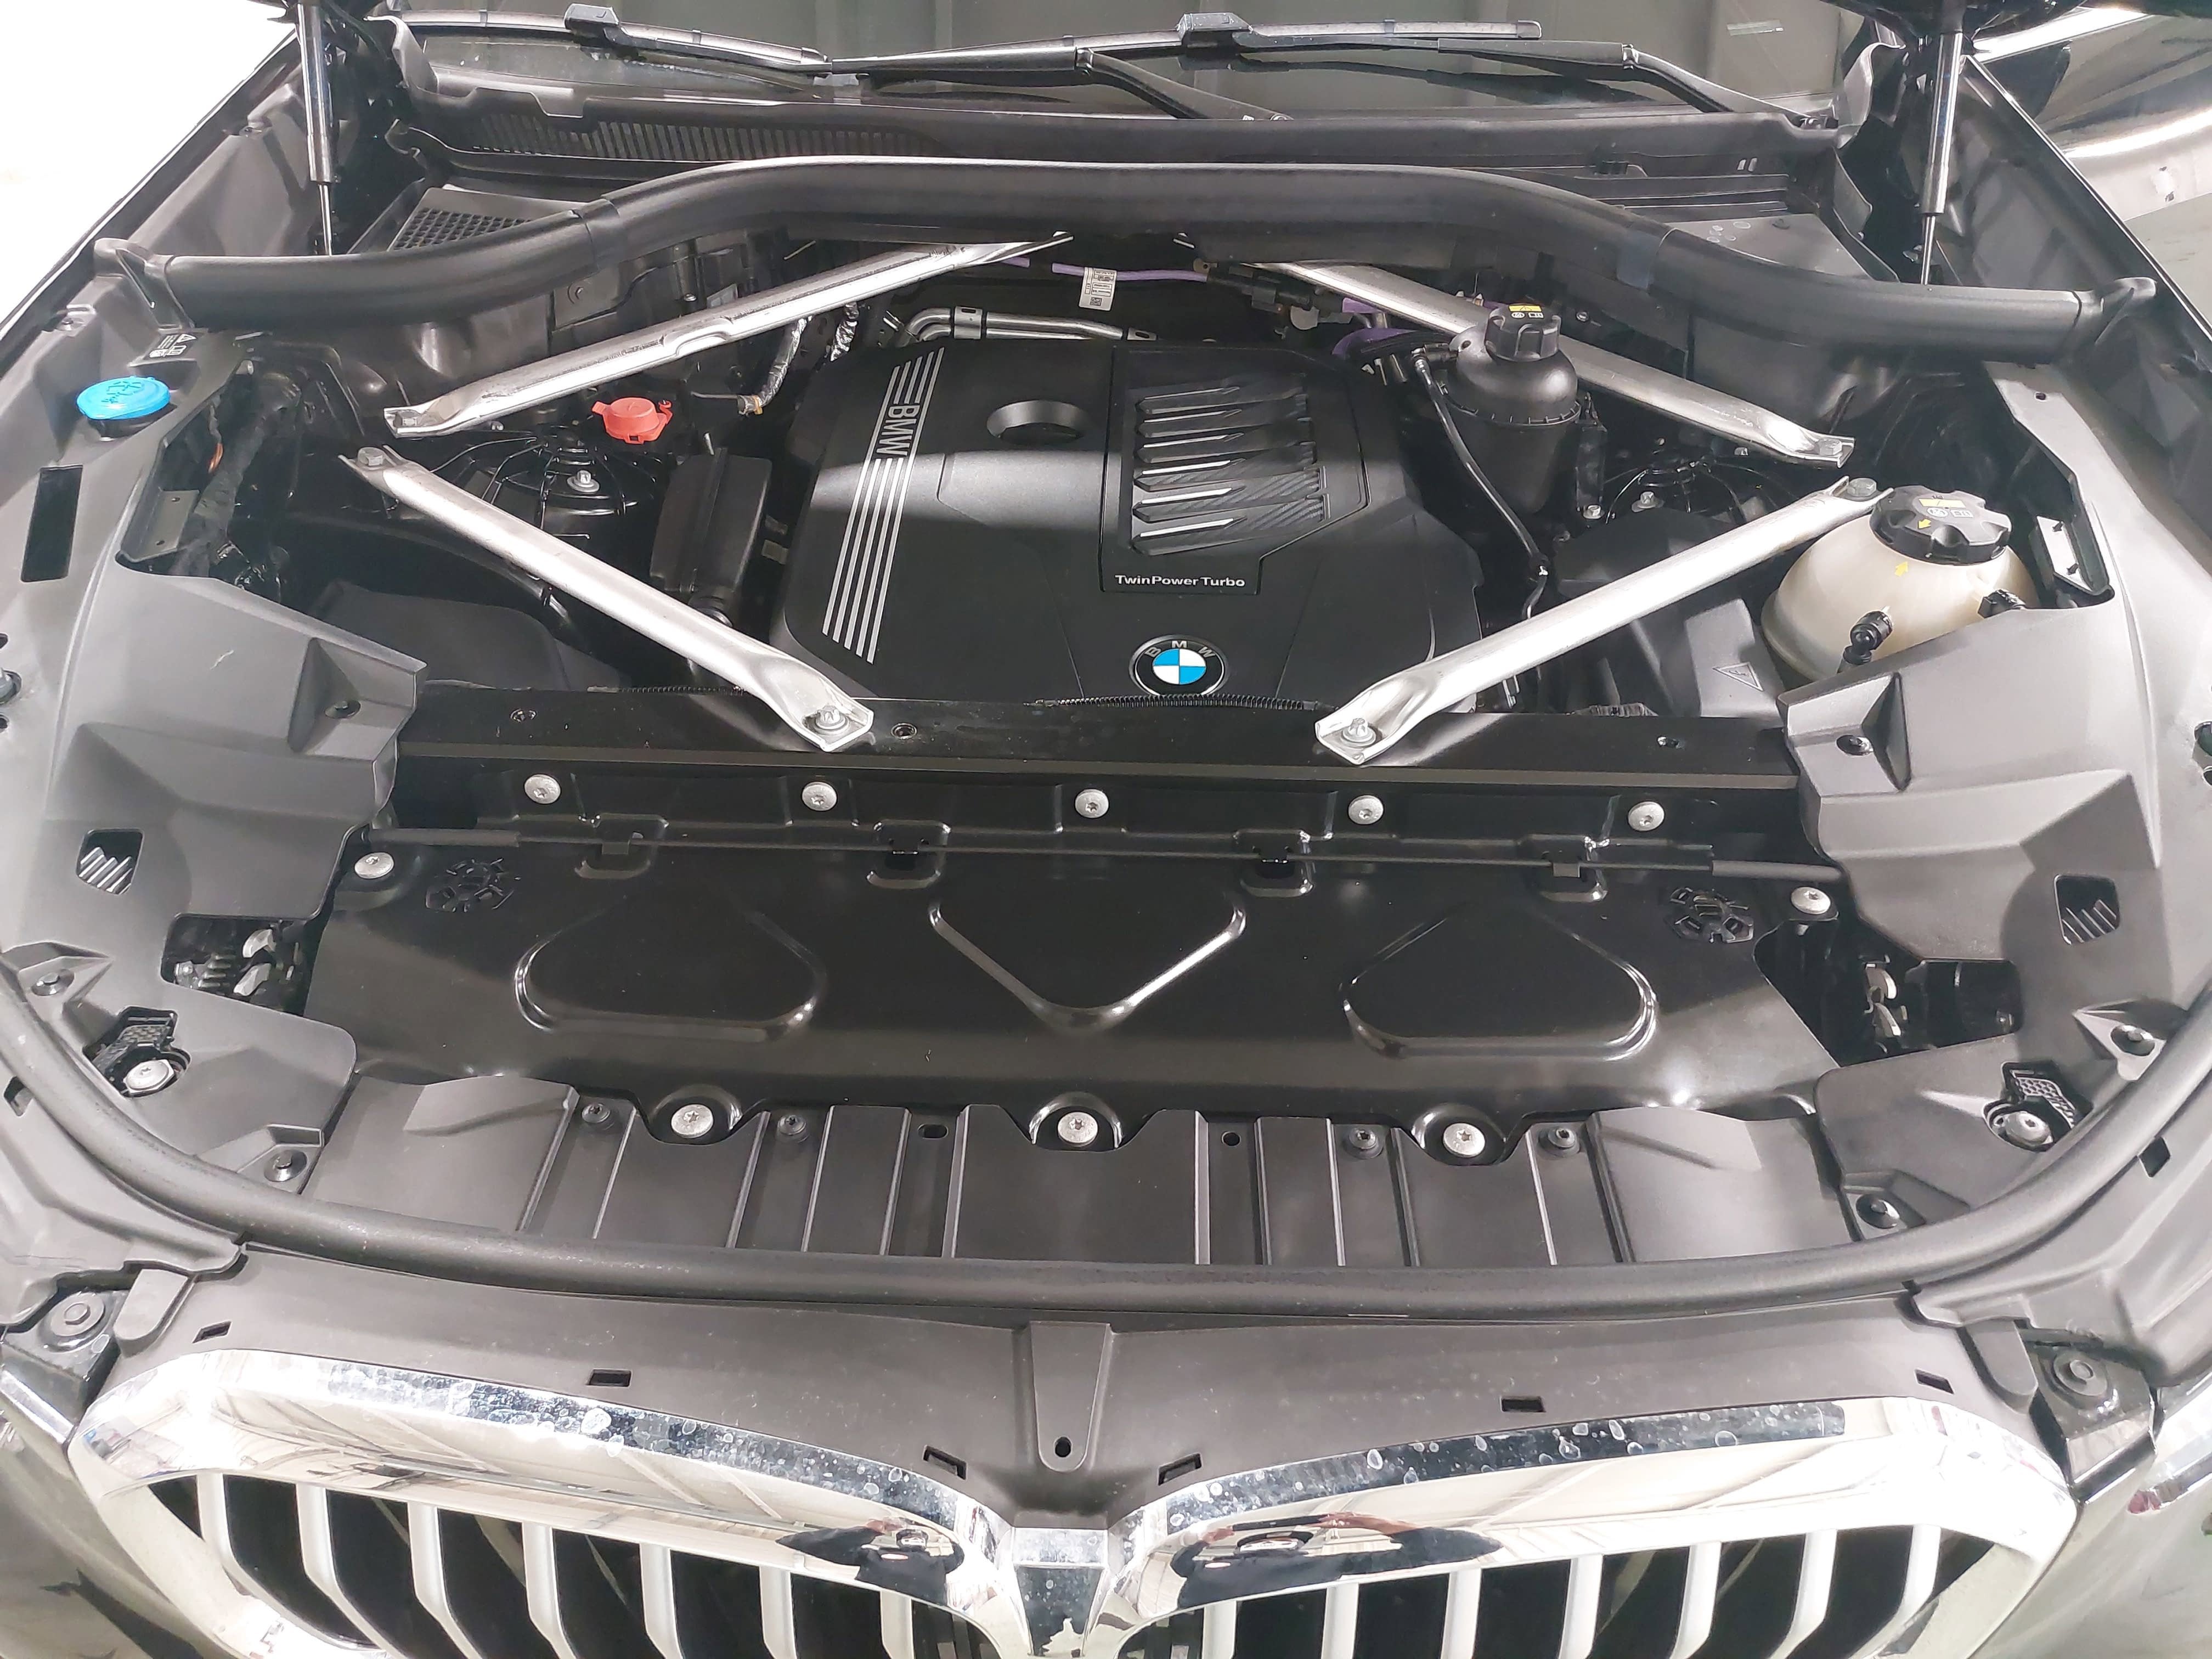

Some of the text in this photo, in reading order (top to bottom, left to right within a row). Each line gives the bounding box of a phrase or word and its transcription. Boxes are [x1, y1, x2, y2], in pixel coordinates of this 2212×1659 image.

[876, 405, 920, 456] BMW
[1115, 575, 1245, 587] TwinPower Turbo
[1144, 640, 1216, 658] BMW
